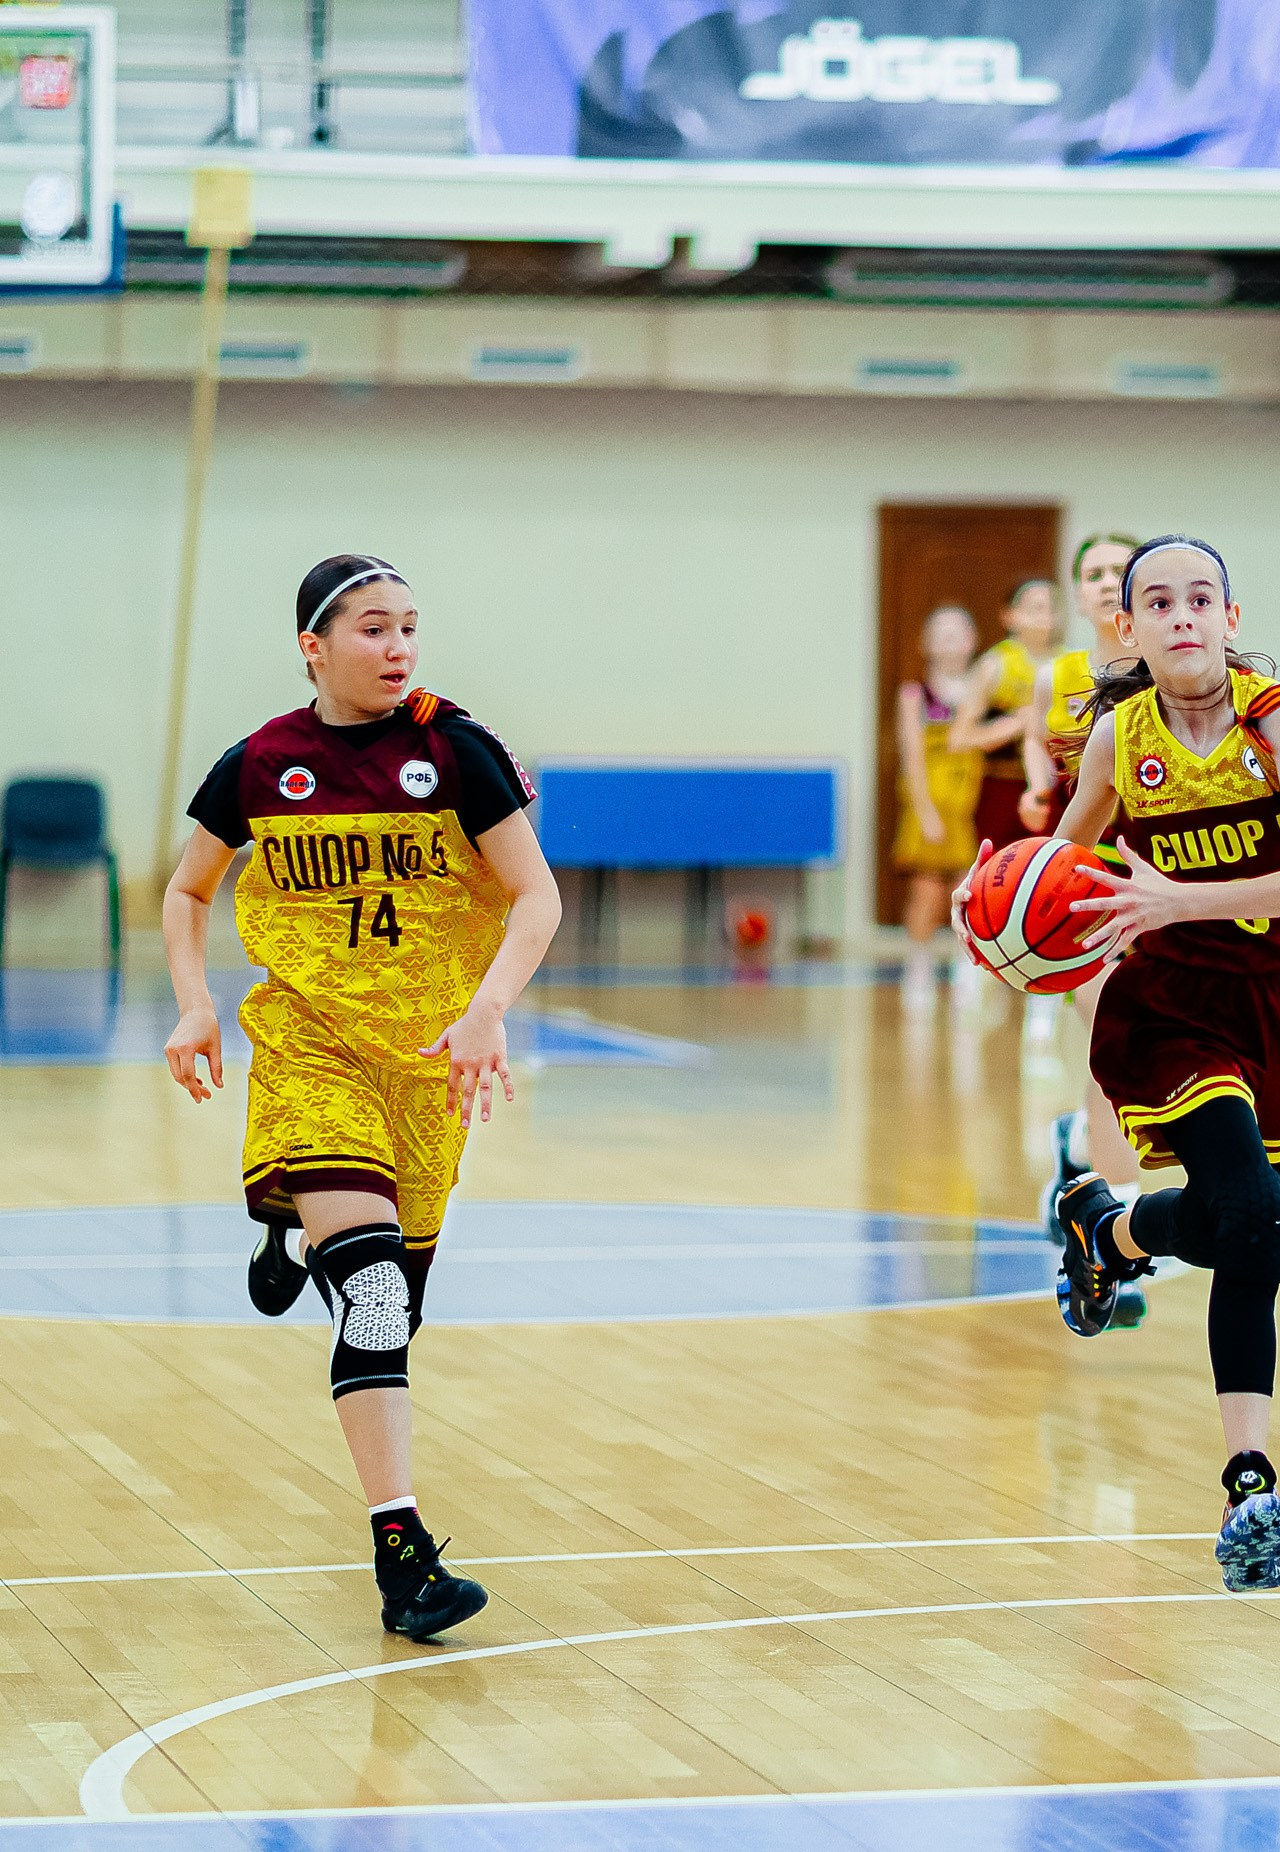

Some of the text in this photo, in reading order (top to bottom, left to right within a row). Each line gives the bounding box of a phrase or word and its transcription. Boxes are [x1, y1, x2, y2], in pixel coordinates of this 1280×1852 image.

[739, 17, 1062, 105] JÖGEL
[406, 772, 433, 783] РФБ
[1150, 797, 1175, 808] SPORT
[262, 833, 370, 892] СШОР
[1150, 820, 1265, 873] СШОР
[337, 893, 403, 949] 74
